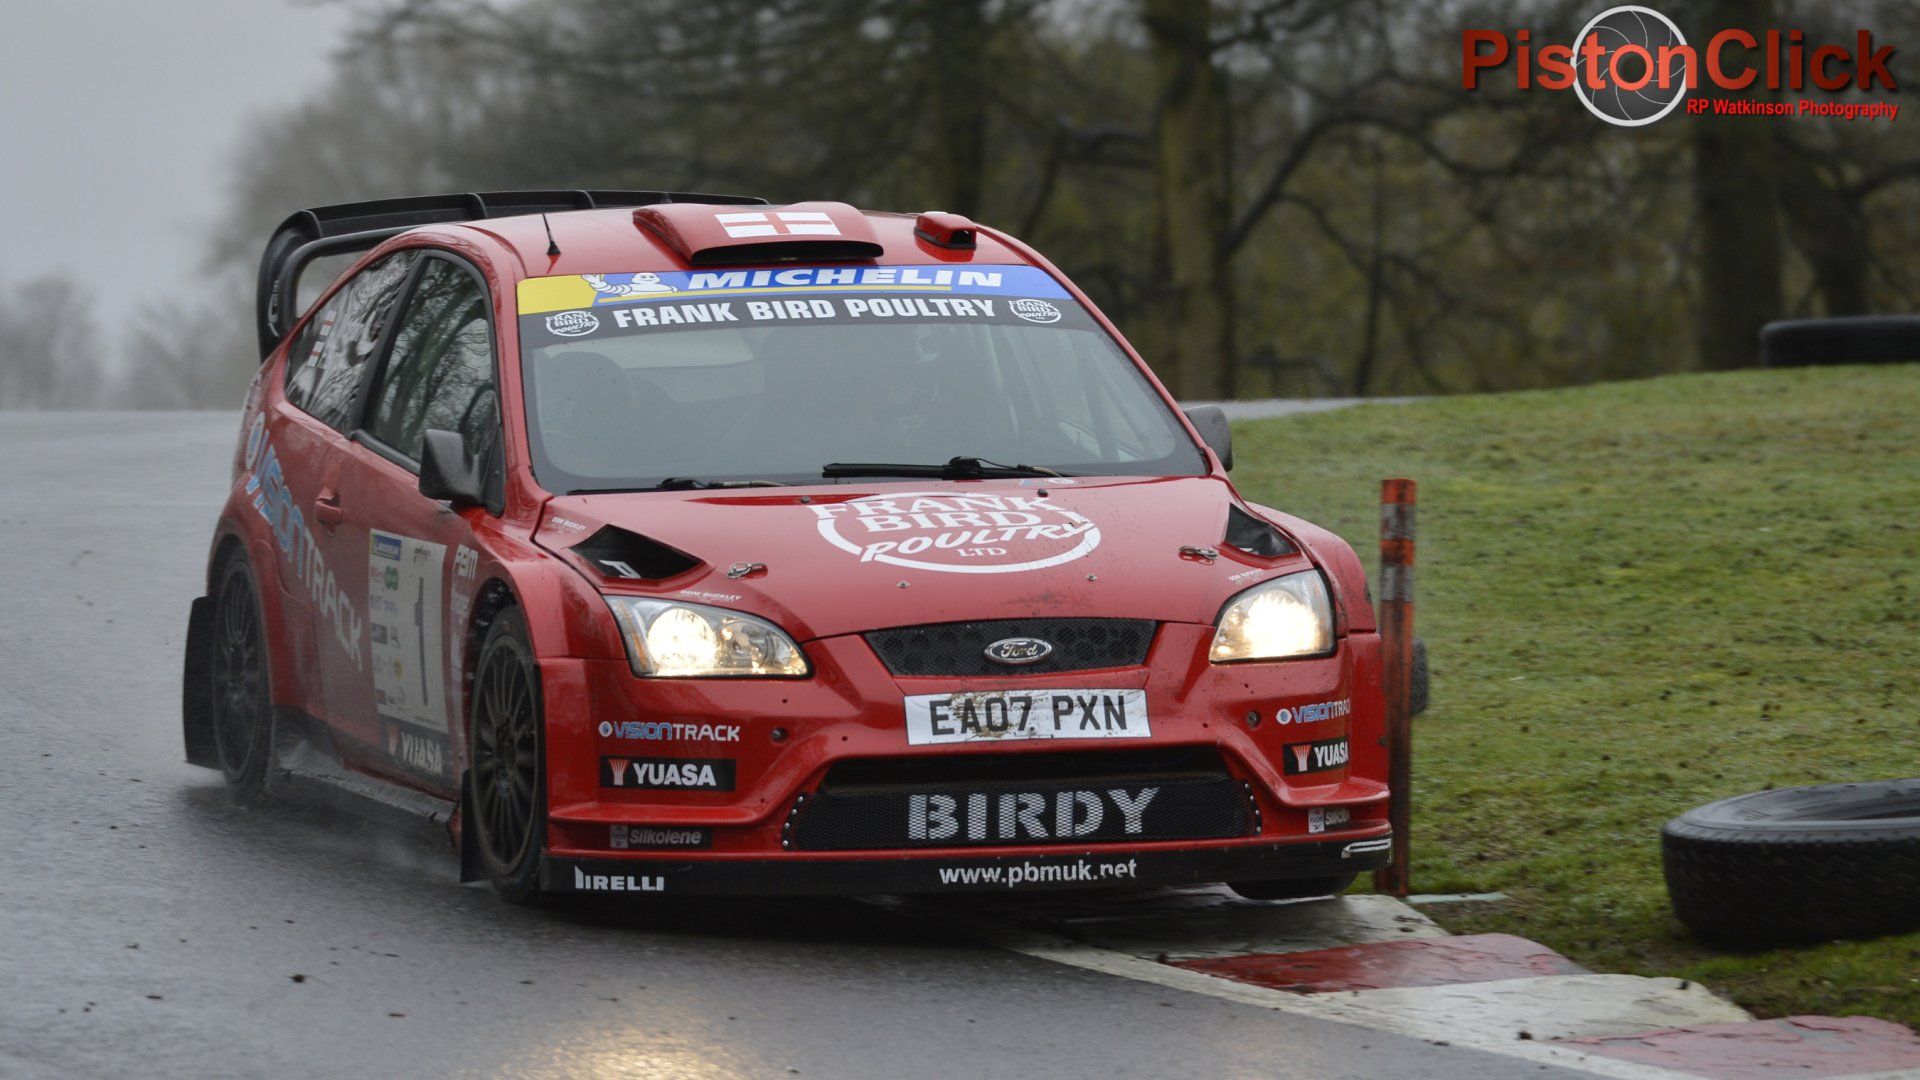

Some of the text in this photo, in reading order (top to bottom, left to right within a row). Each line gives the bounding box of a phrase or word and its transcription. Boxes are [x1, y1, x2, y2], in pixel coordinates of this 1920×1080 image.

[688, 269, 1002, 290] MICHELIN
[613, 298, 995, 328] FRANK BIRD POULTRY
[806, 496, 1066, 520] FRANK
[856, 511, 1042, 532] BIRD
[860, 522, 1096, 562] POULTRY
[959, 546, 1007, 557] LTD
[414, 577, 429, 706] 1
[1001, 641, 1038, 658] Ford
[929, 695, 1127, 736] EA07 PXN
[614, 721, 740, 742] VISIONTRACK
[633, 762, 717, 787] YUASA
[908, 787, 1160, 840] BIRDY
[629, 828, 701, 844] Silkolene
[939, 859, 1137, 888] www.pbmuk.net
